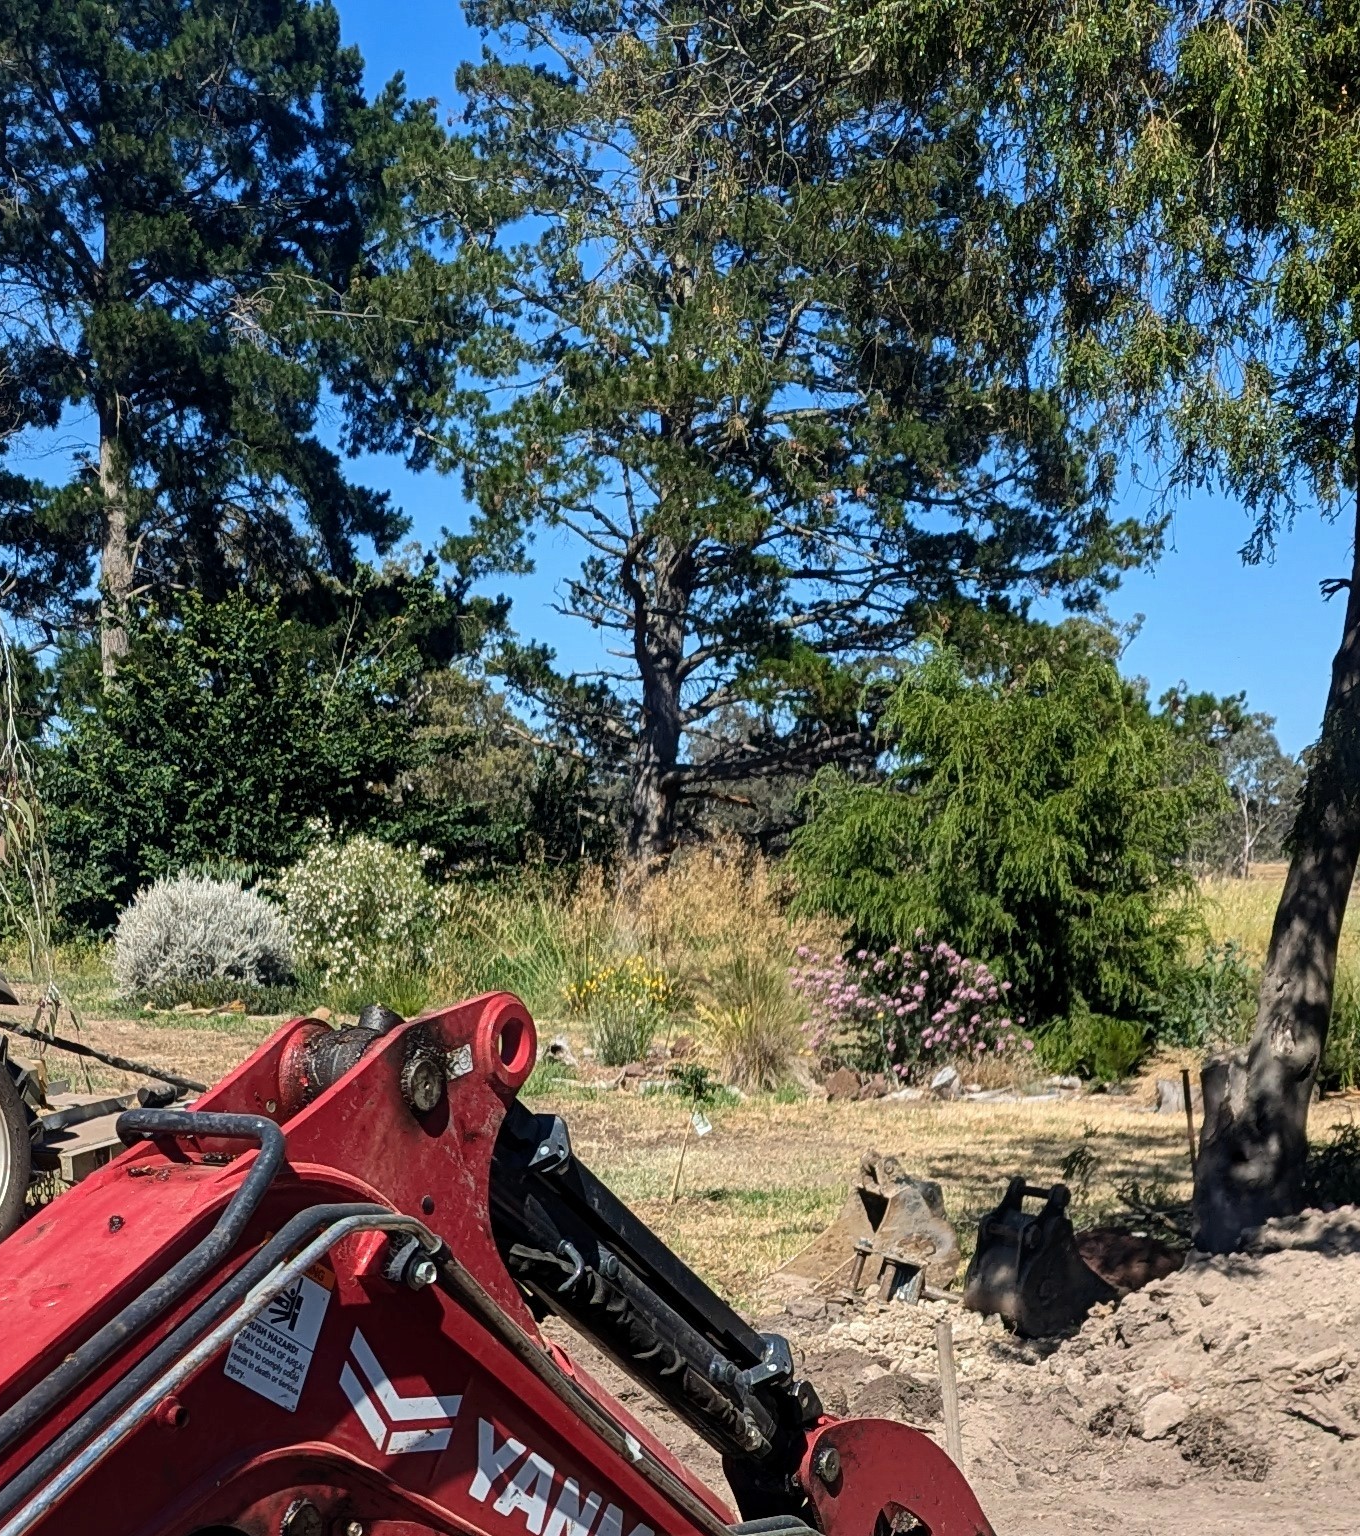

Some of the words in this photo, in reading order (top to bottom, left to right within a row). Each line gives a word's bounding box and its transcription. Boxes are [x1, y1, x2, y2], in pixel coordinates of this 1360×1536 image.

[234, 1340, 255, 1356] Failure
[254, 1351, 262, 1360] to
[262, 1356, 282, 1374] comply
[255, 1338, 277, 1356] CLEAR
[276, 1350, 287, 1360] OF
[231, 1352, 249, 1366] result
[248, 1362, 255, 1370] in
[254, 1365, 271, 1380] death
[271, 1375, 278, 1383] or
[278, 1379, 299, 1396] serious
